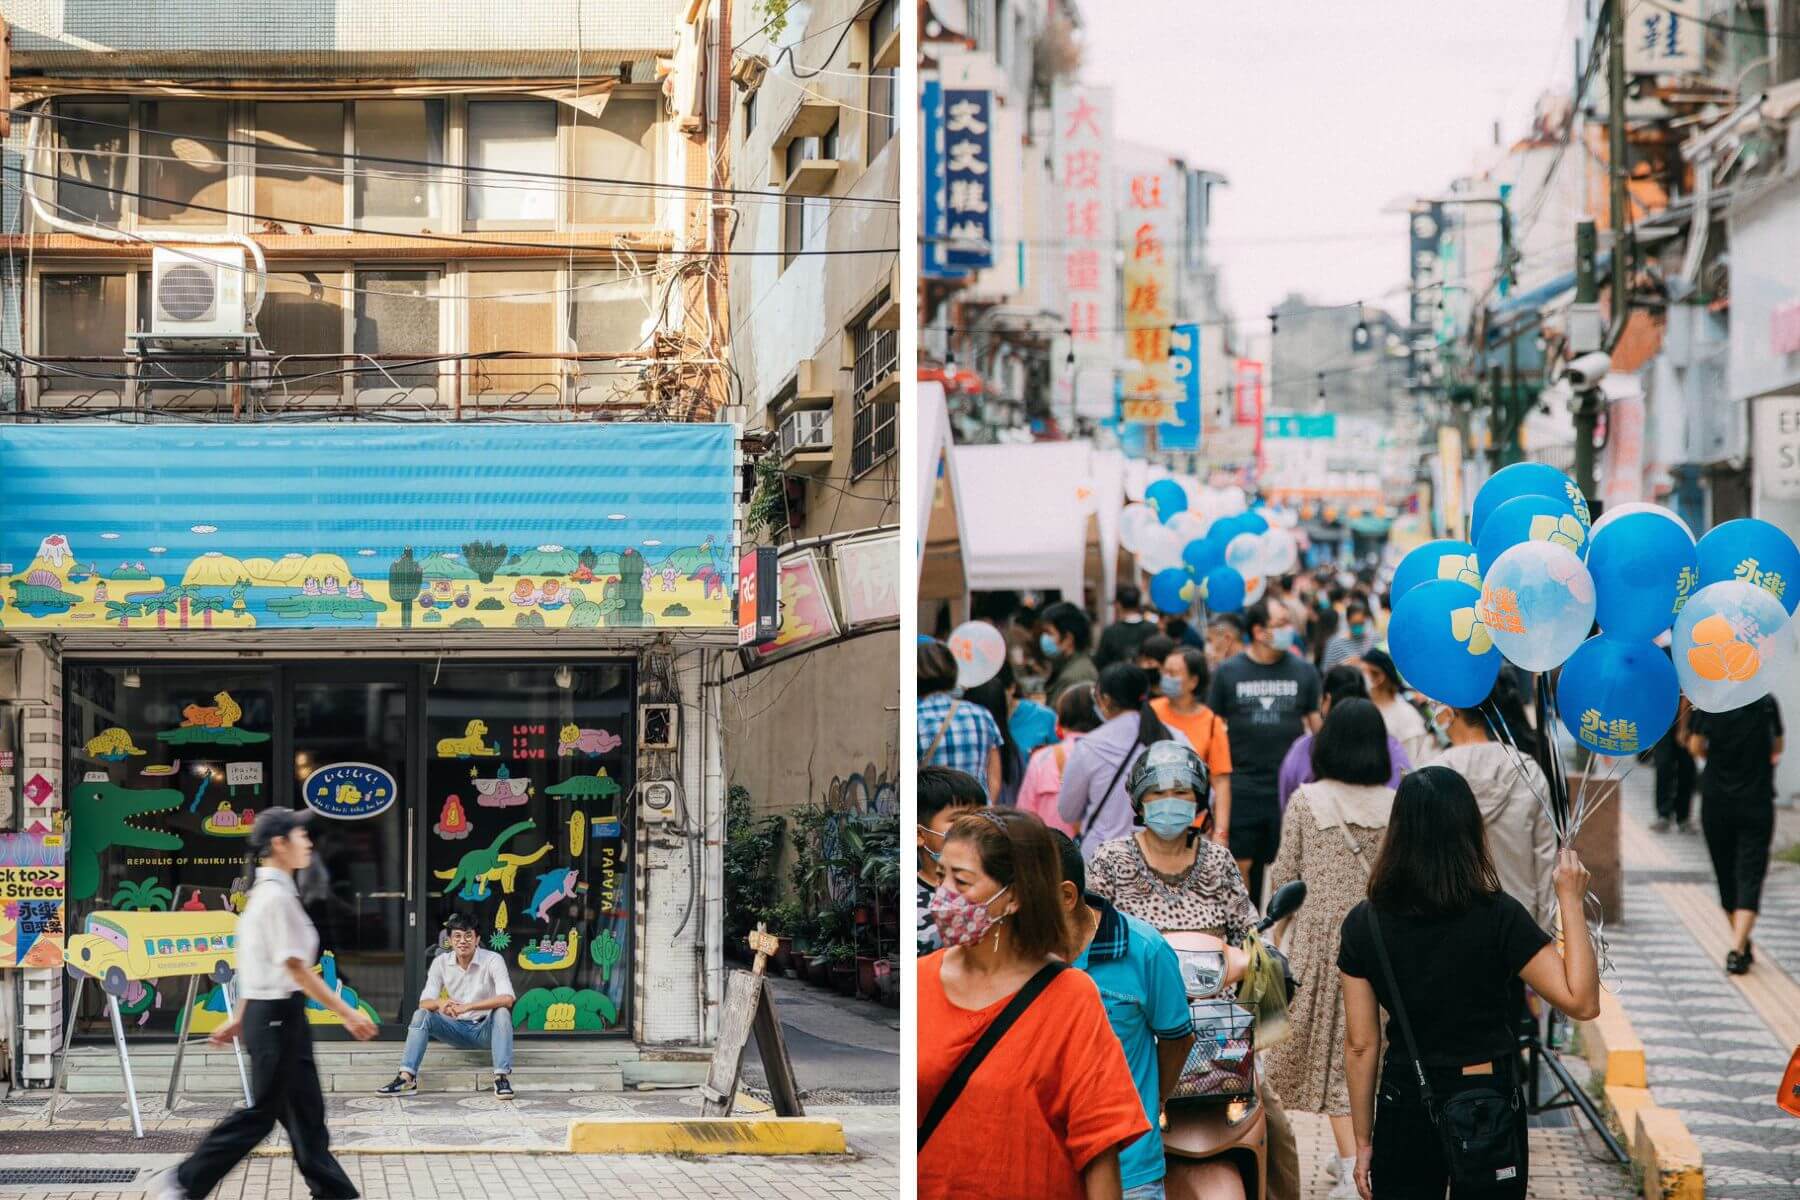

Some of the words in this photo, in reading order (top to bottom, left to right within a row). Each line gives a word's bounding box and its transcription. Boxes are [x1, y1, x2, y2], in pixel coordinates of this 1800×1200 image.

[513, 725, 545, 735] LOVE
[513, 738, 528, 747] IS
[513, 749, 545, 759] LOVE
[7, 883, 63, 897] Street
[19, 902, 59, 920] 永樂
